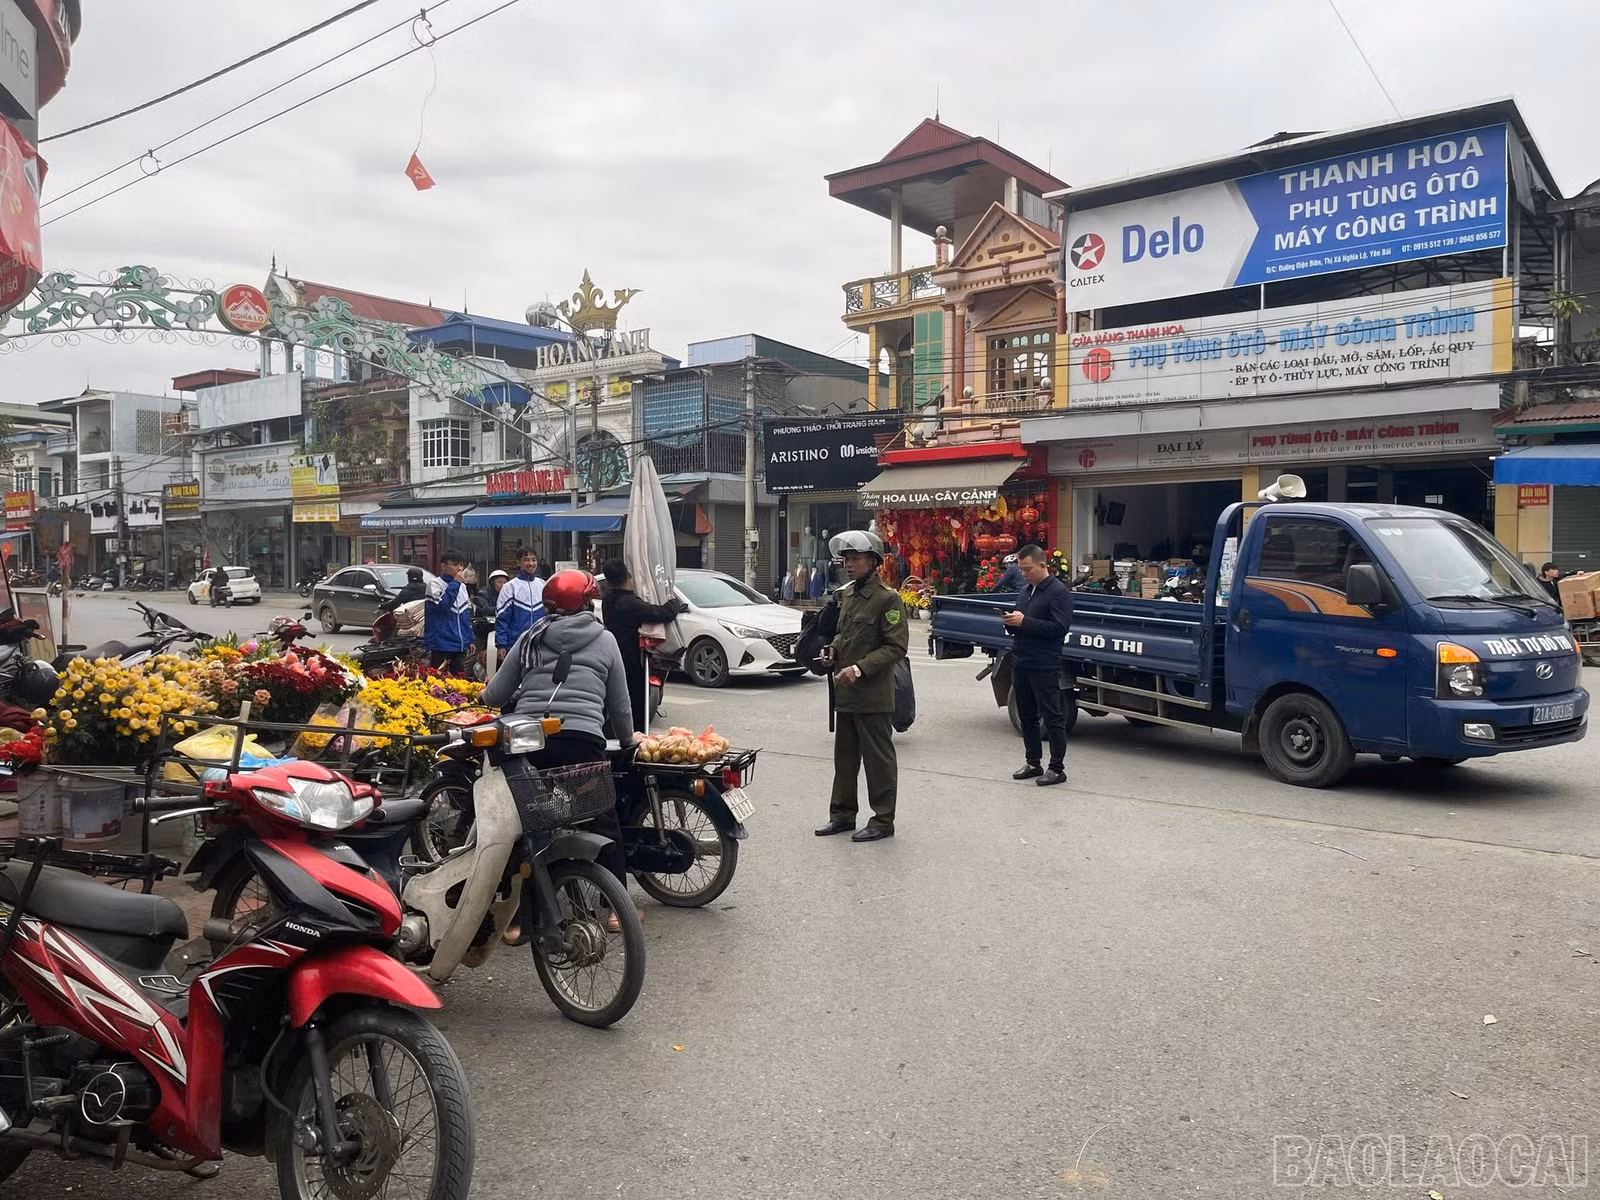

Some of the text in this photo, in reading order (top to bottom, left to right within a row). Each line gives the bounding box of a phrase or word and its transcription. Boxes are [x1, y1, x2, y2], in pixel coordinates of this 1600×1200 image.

[1279, 136, 1484, 194] THANH HOA
[1289, 166, 1479, 222] PHỤ TÙNG ÔTÔ
[1275, 197, 1498, 251] MÁY CÔNG TRÌNH
[1122, 215, 1205, 264] Delo
[1429, 240, 1441, 248] 512
[1070, 274, 1105, 288] CALTEX
[1126, 328, 1161, 340] THANH
[1162, 324, 1185, 336] HOA
[1129, 343, 1167, 369] PHỤ
[1171, 336, 1222, 363] TÙNG
[1228, 328, 1266, 357] ÔTÔ
[1280, 321, 1328, 352] MÁY
[1335, 315, 1397, 346] CÔNG
[1403, 306, 1475, 339] TRÌNH
[607, 327, 651, 358] ANH
[1236, 363, 1257, 374] BÁN
[1260, 360, 1280, 370] CÁC
[1284, 357, 1309, 369] LOẠI
[1448, 341, 1475, 353] QUY
[1252, 376, 1267, 384] TY
[1345, 364, 1370, 376] MÁY
[1373, 361, 1405, 374] CÔNG
[1409, 357, 1450, 370] TRÌNH
[773, 424, 801, 435] PHƯƠNG
[802, 422, 821, 432] THẢO
[826, 420, 841, 431] THỜI
[842, 419, 867, 429] TRANG
[868, 418, 886, 427] NAM
[770, 448, 829, 464] ARISTINO
[1157, 438, 1204, 454] ĐẠI LÝ
[882, 494, 906, 503] HOA
[909, 493, 930, 504] LỤA
[935, 490, 959, 501] CÂY
[961, 488, 997, 500] CẢNH
[1080, 634, 1107, 649] ĐÔ
[1482, 634, 1574, 657] TRẬT TỰ ĐÔ THỊ
[285, 921, 321, 938] HONDA
